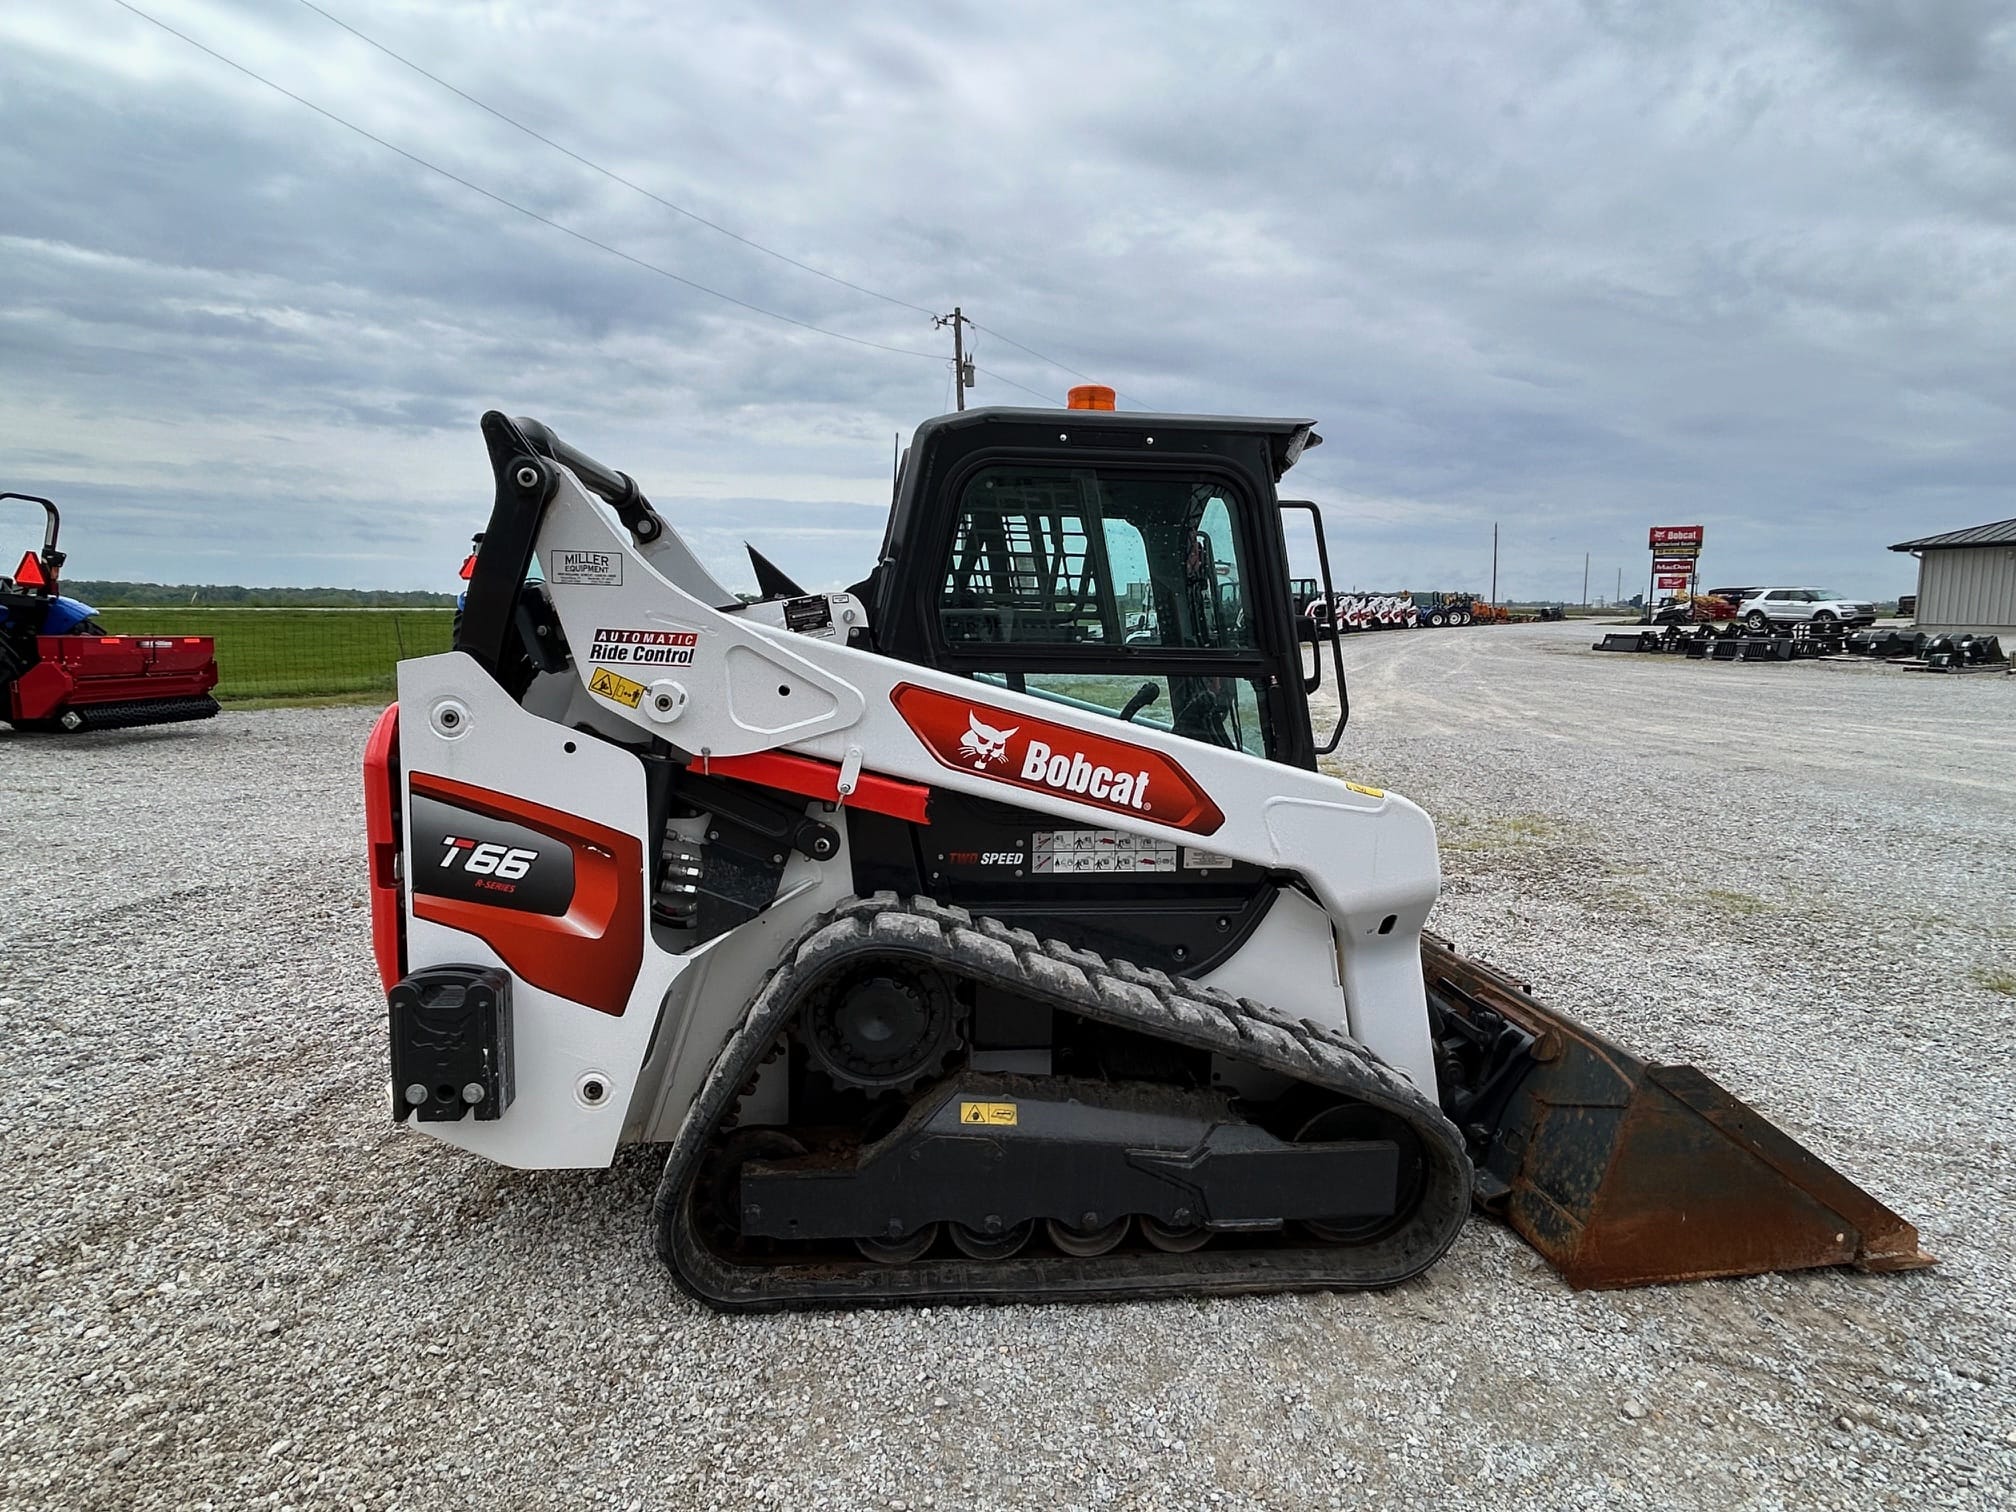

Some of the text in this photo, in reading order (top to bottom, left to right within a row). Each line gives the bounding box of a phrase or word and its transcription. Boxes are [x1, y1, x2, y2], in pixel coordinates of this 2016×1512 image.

[1667, 531, 1696, 539] Bobcat
[565, 553, 609, 566] MILLER
[565, 565, 609, 573] EQUIPMENT
[599, 631, 693, 645] AUTOMATIC
[590, 644, 694, 663] Ride Control
[1021, 740, 1150, 809] Bobcat
[440, 837, 539, 880] T66
[950, 853, 1023, 865] TWO SPEED
[475, 880, 516, 893] R-SERIES
